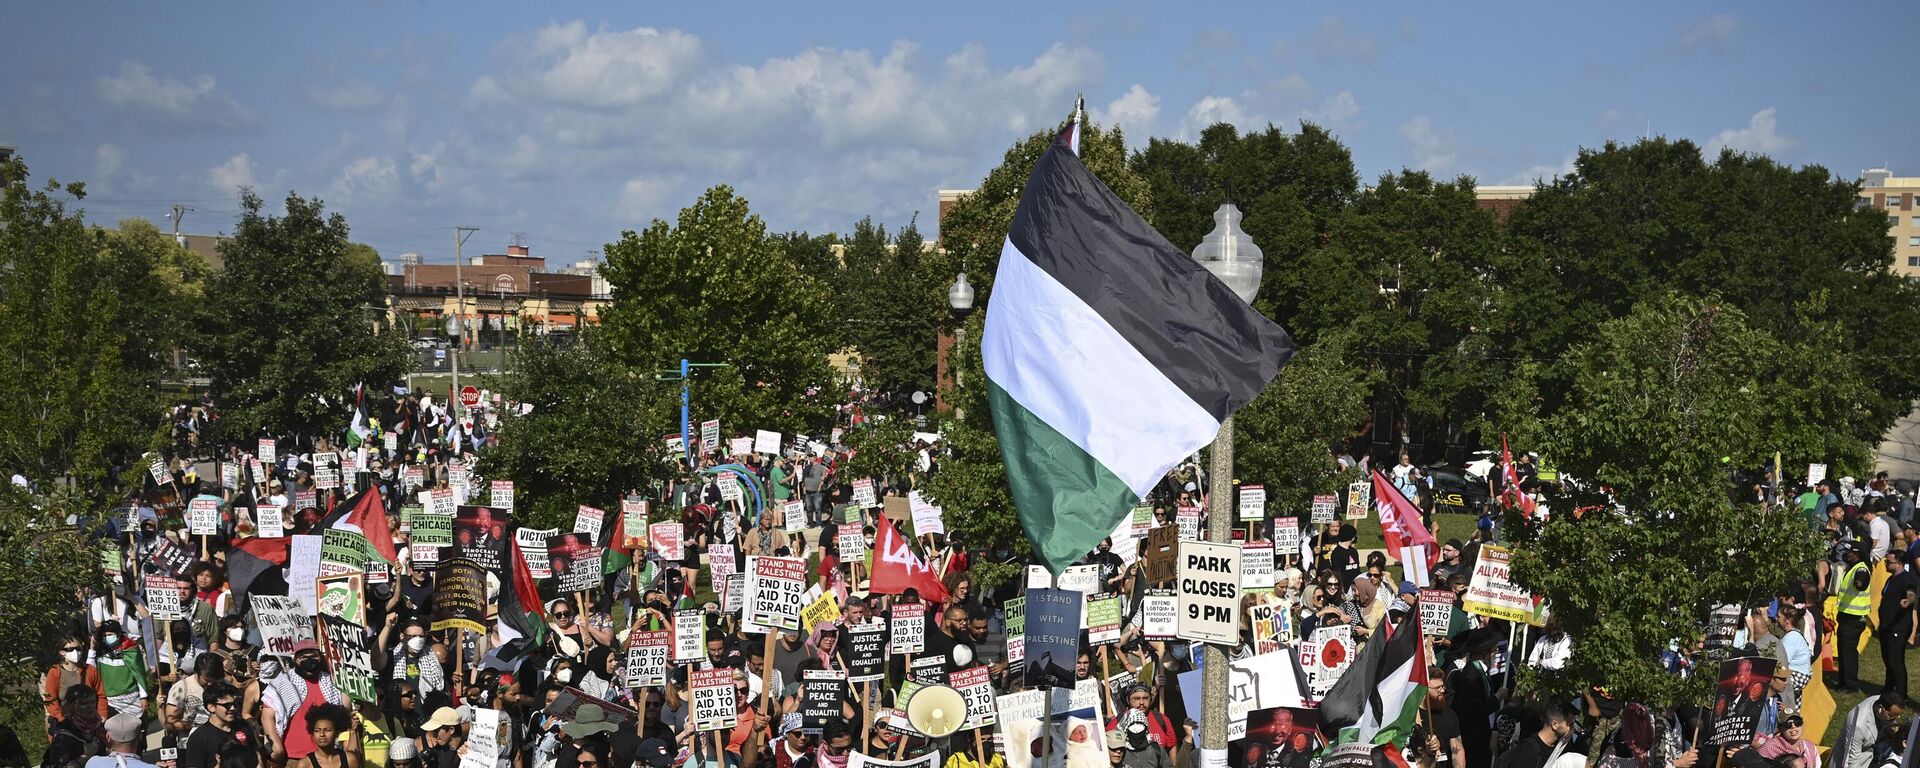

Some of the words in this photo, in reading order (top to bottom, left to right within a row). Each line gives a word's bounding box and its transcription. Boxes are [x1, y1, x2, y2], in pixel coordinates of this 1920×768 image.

[462, 393, 477, 401] STOP
[315, 454, 336, 462] VICTORY
[412, 521, 450, 529] CHICAGO
[324, 536, 365, 554] CHICAGO
[322, 552, 364, 569] PALESTINE
[1489, 550, 1508, 560] Torah
[760, 559, 784, 568] STAND
[787, 562, 805, 570] WITH
[1188, 554, 1231, 573] PARK
[758, 567, 804, 581] PALESTINE!
[1477, 565, 1490, 577] ALL
[576, 574, 600, 582] ISRAEL!
[440, 586, 482, 595] REPUBLICANS
[758, 578, 780, 589] END
[784, 582, 800, 593] U.S
[1182, 578, 1236, 599] CLOSES
[477, 597, 486, 606] ON
[757, 589, 778, 600] AID
[785, 593, 799, 604] TO
[1040, 595, 1072, 604] STAND
[1499, 592, 1529, 606] Sovereignty
[150, 603, 179, 611] ISRAEL!
[459, 602, 481, 610] HANDS!
[756, 601, 798, 616] ISRAEL!
[806, 598, 830, 621] ABANDON
[1188, 604, 1199, 619] 9
[1204, 605, 1231, 623] PM
[1253, 607, 1271, 620] NO
[1474, 606, 1524, 620] www.nkusa.org
[1040, 615, 1064, 624] WITH
[893, 635, 922, 644] ISRAEL!
[1026, 635, 1076, 646] PALESTINE
[1278, 632, 1290, 641] IN
[1009, 651, 1016, 659] IS
[629, 659, 648, 667] AID
[852, 658, 881, 666] EQUALITY!
[629, 667, 663, 676] ISRAEL!
[951, 673, 971, 681] STAND
[692, 678, 732, 687] PALESTINE!
[951, 676, 989, 687] PALESTINE!
[695, 689, 713, 699] END
[717, 688, 731, 696] U.S
[975, 685, 988, 694] U.S
[696, 699, 714, 709] AID
[719, 697, 732, 706] TO
[977, 695, 990, 704] TO
[697, 708, 734, 719] ISRAEL!
[968, 705, 992, 716] RAEL!
[1715, 716, 1750, 728] DEMOCRATS
